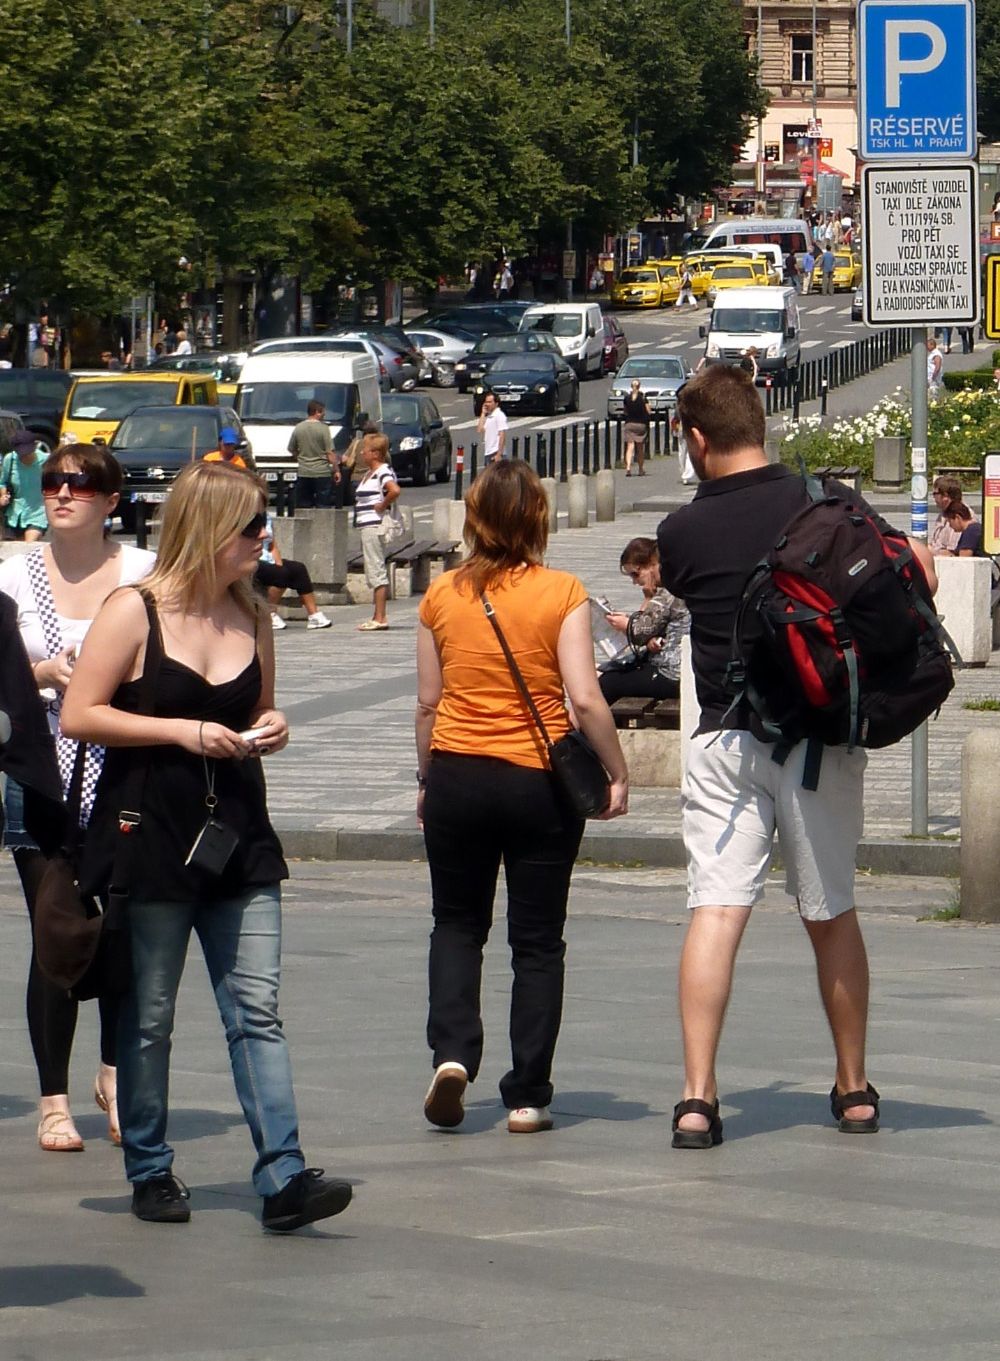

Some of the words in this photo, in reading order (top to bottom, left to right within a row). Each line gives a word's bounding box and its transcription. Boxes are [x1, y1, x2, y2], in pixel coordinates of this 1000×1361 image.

[885, 20, 947, 108] P
[870, 114, 964, 136] RÉSERVÉ
[871, 138, 891, 148] TSK
[929, 138, 963, 148] PRAHY
[875, 179, 928, 194] STANOVIŠTĚ
[932, 180, 968, 193] VOZIDEL
[882, 198, 901, 210] TAXI
[906, 197, 923, 210] DLE
[927, 194, 962, 209] ZÁKONA
[900, 212, 939, 226] 111/1994
[941, 212, 956, 225] SB.
[901, 229, 921, 243] PRO
[924, 225, 941, 242] PĚT
[897, 243, 922, 259] VOZŮ
[924, 245, 945, 259] TAXI
[947, 245, 960, 258] SE
[875, 262, 926, 277] SOUHLASEM
[929, 259, 968, 275] SPRÁVCE
[882, 280, 898, 294] EVA
[900, 276, 956, 294] KVASNIČKOVÁ
[876, 297, 882, 311] A
[884, 294, 950, 310] RADIODISPEČINK
[951, 295, 969, 309] TAXI
